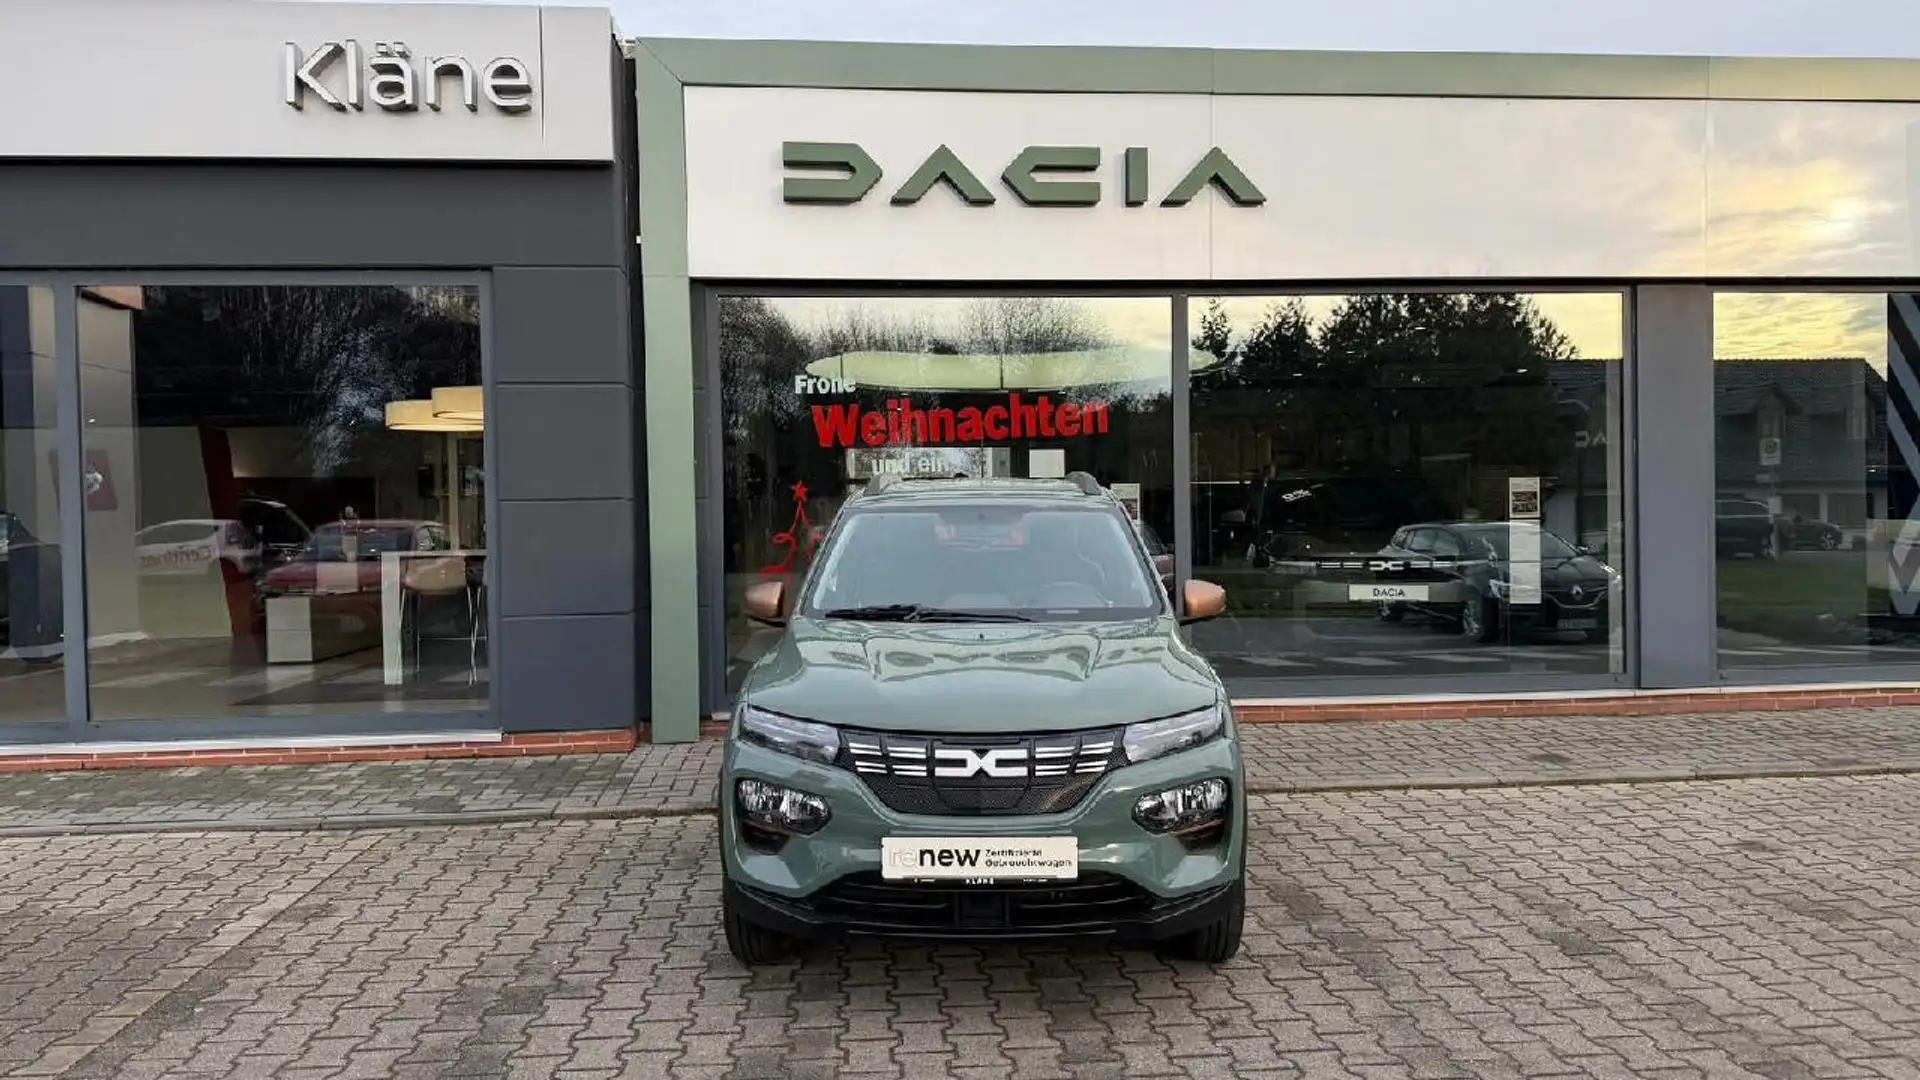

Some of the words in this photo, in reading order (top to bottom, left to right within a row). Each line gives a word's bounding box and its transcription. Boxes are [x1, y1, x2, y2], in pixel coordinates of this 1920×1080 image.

[284, 38, 532, 114] Kläne
[783, 140, 1267, 207] DACIA
[811, 393, 1109, 448] Weihnachten
[1373, 587, 1405, 597] DACIA
[889, 848, 981, 867] renew
